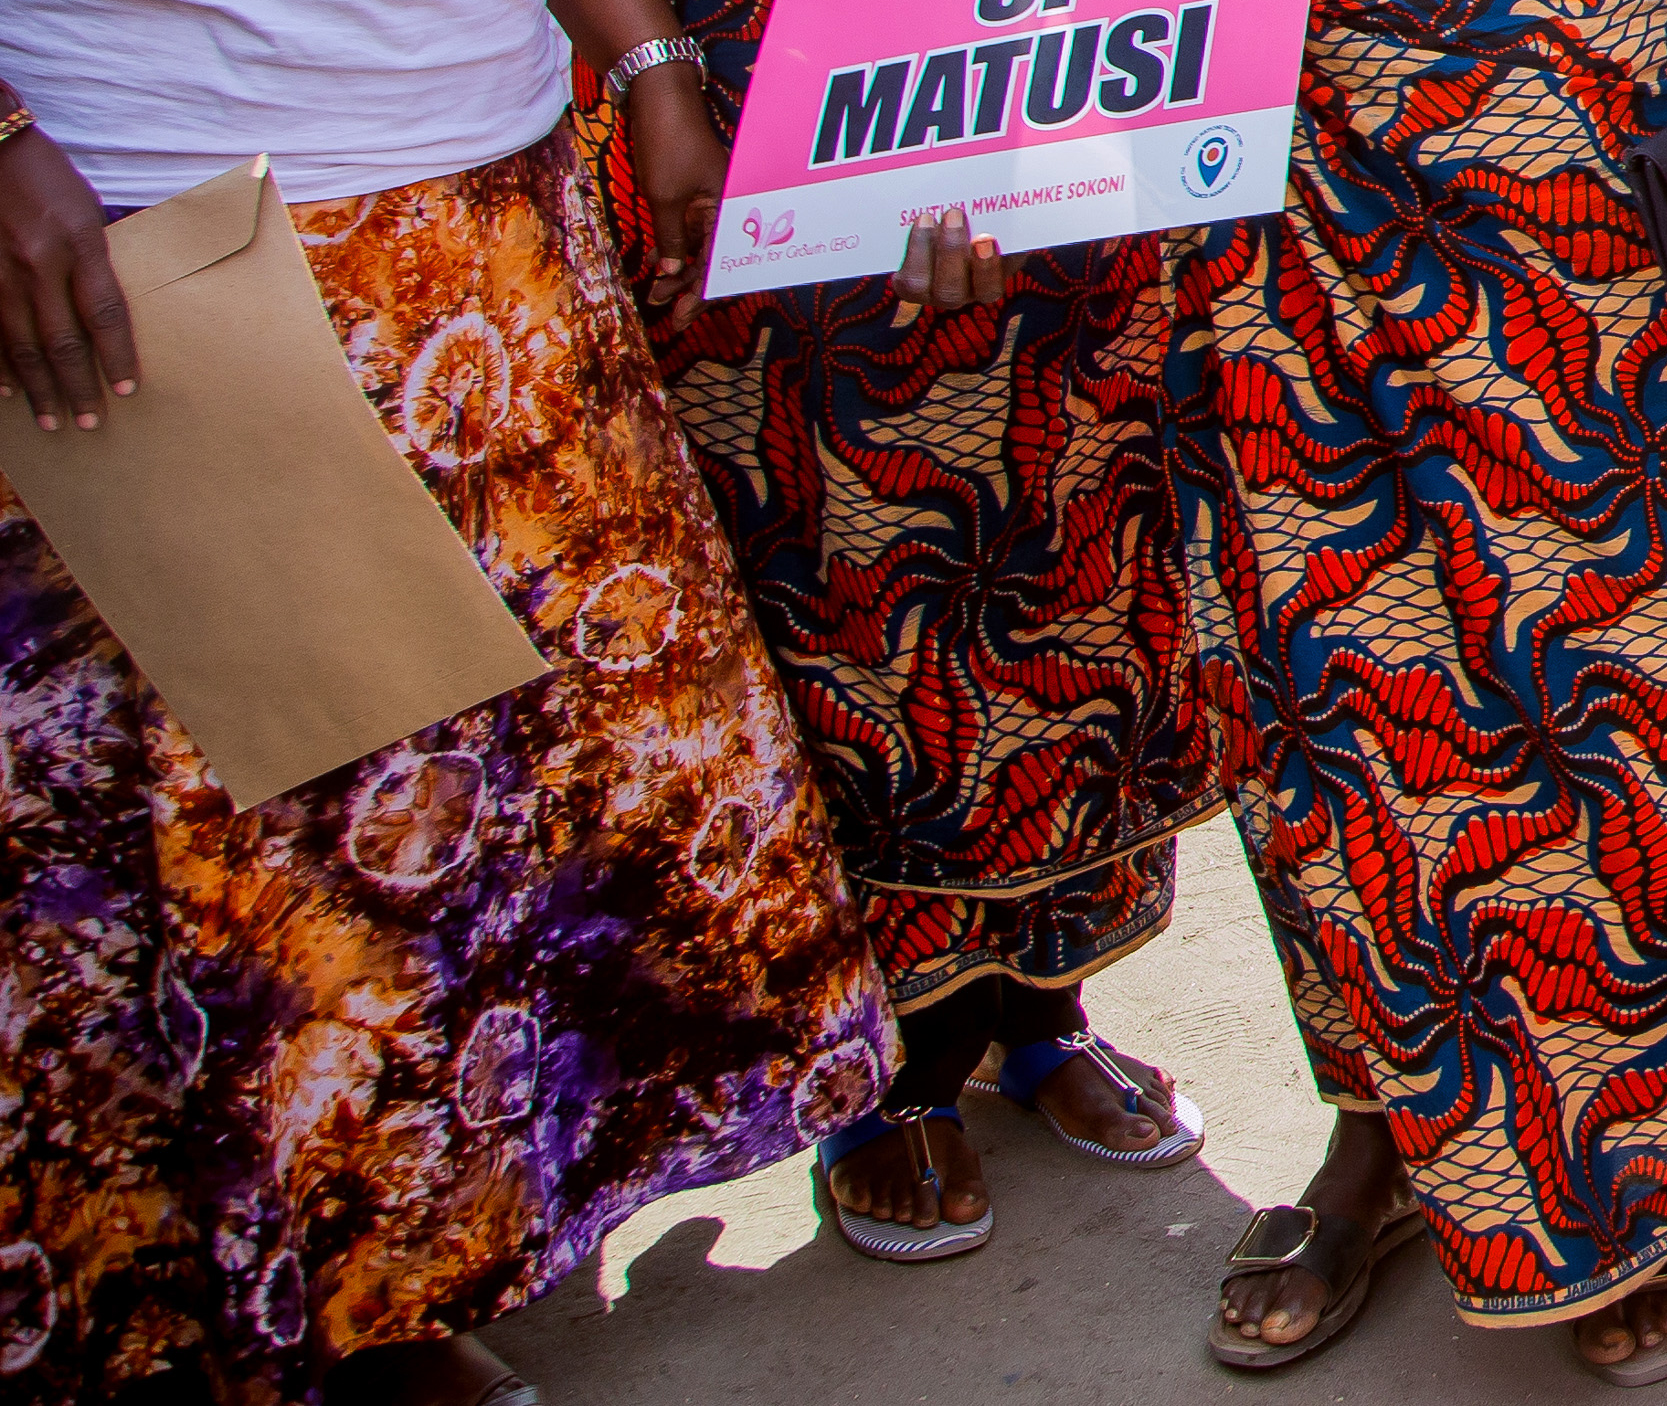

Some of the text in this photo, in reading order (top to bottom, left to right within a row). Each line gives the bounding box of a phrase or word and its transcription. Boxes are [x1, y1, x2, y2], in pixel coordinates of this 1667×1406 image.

[972, 185, 1063, 216] MWANAMKE
[1067, 175, 1126, 200] SOKONI
[720, 252, 764, 273] Equality
[767, 249, 782, 262] for
